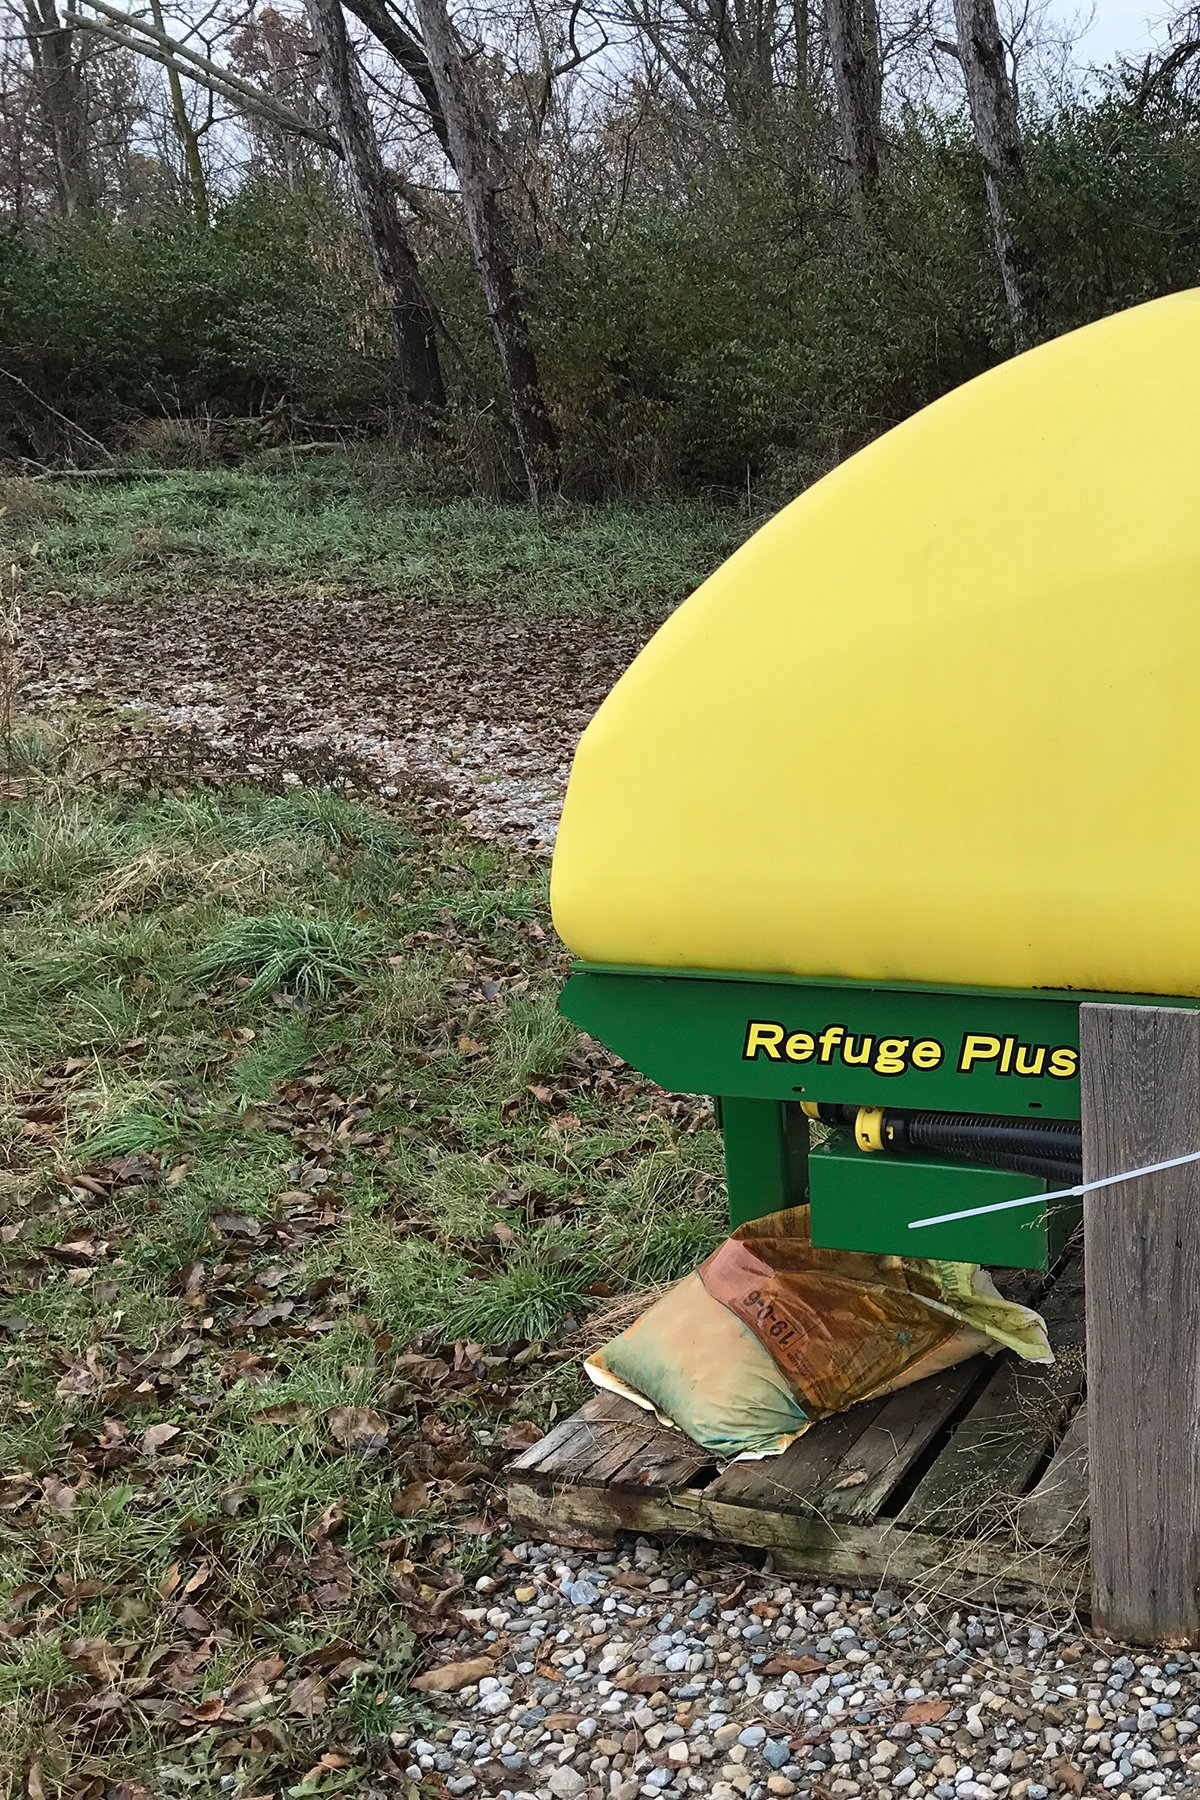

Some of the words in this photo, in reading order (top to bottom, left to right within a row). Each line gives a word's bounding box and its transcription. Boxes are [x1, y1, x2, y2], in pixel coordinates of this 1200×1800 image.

[743, 1020, 944, 1076] Refuge
[958, 1034, 1080, 1078] Plus
[743, 1290, 795, 1345] 19-0-6
